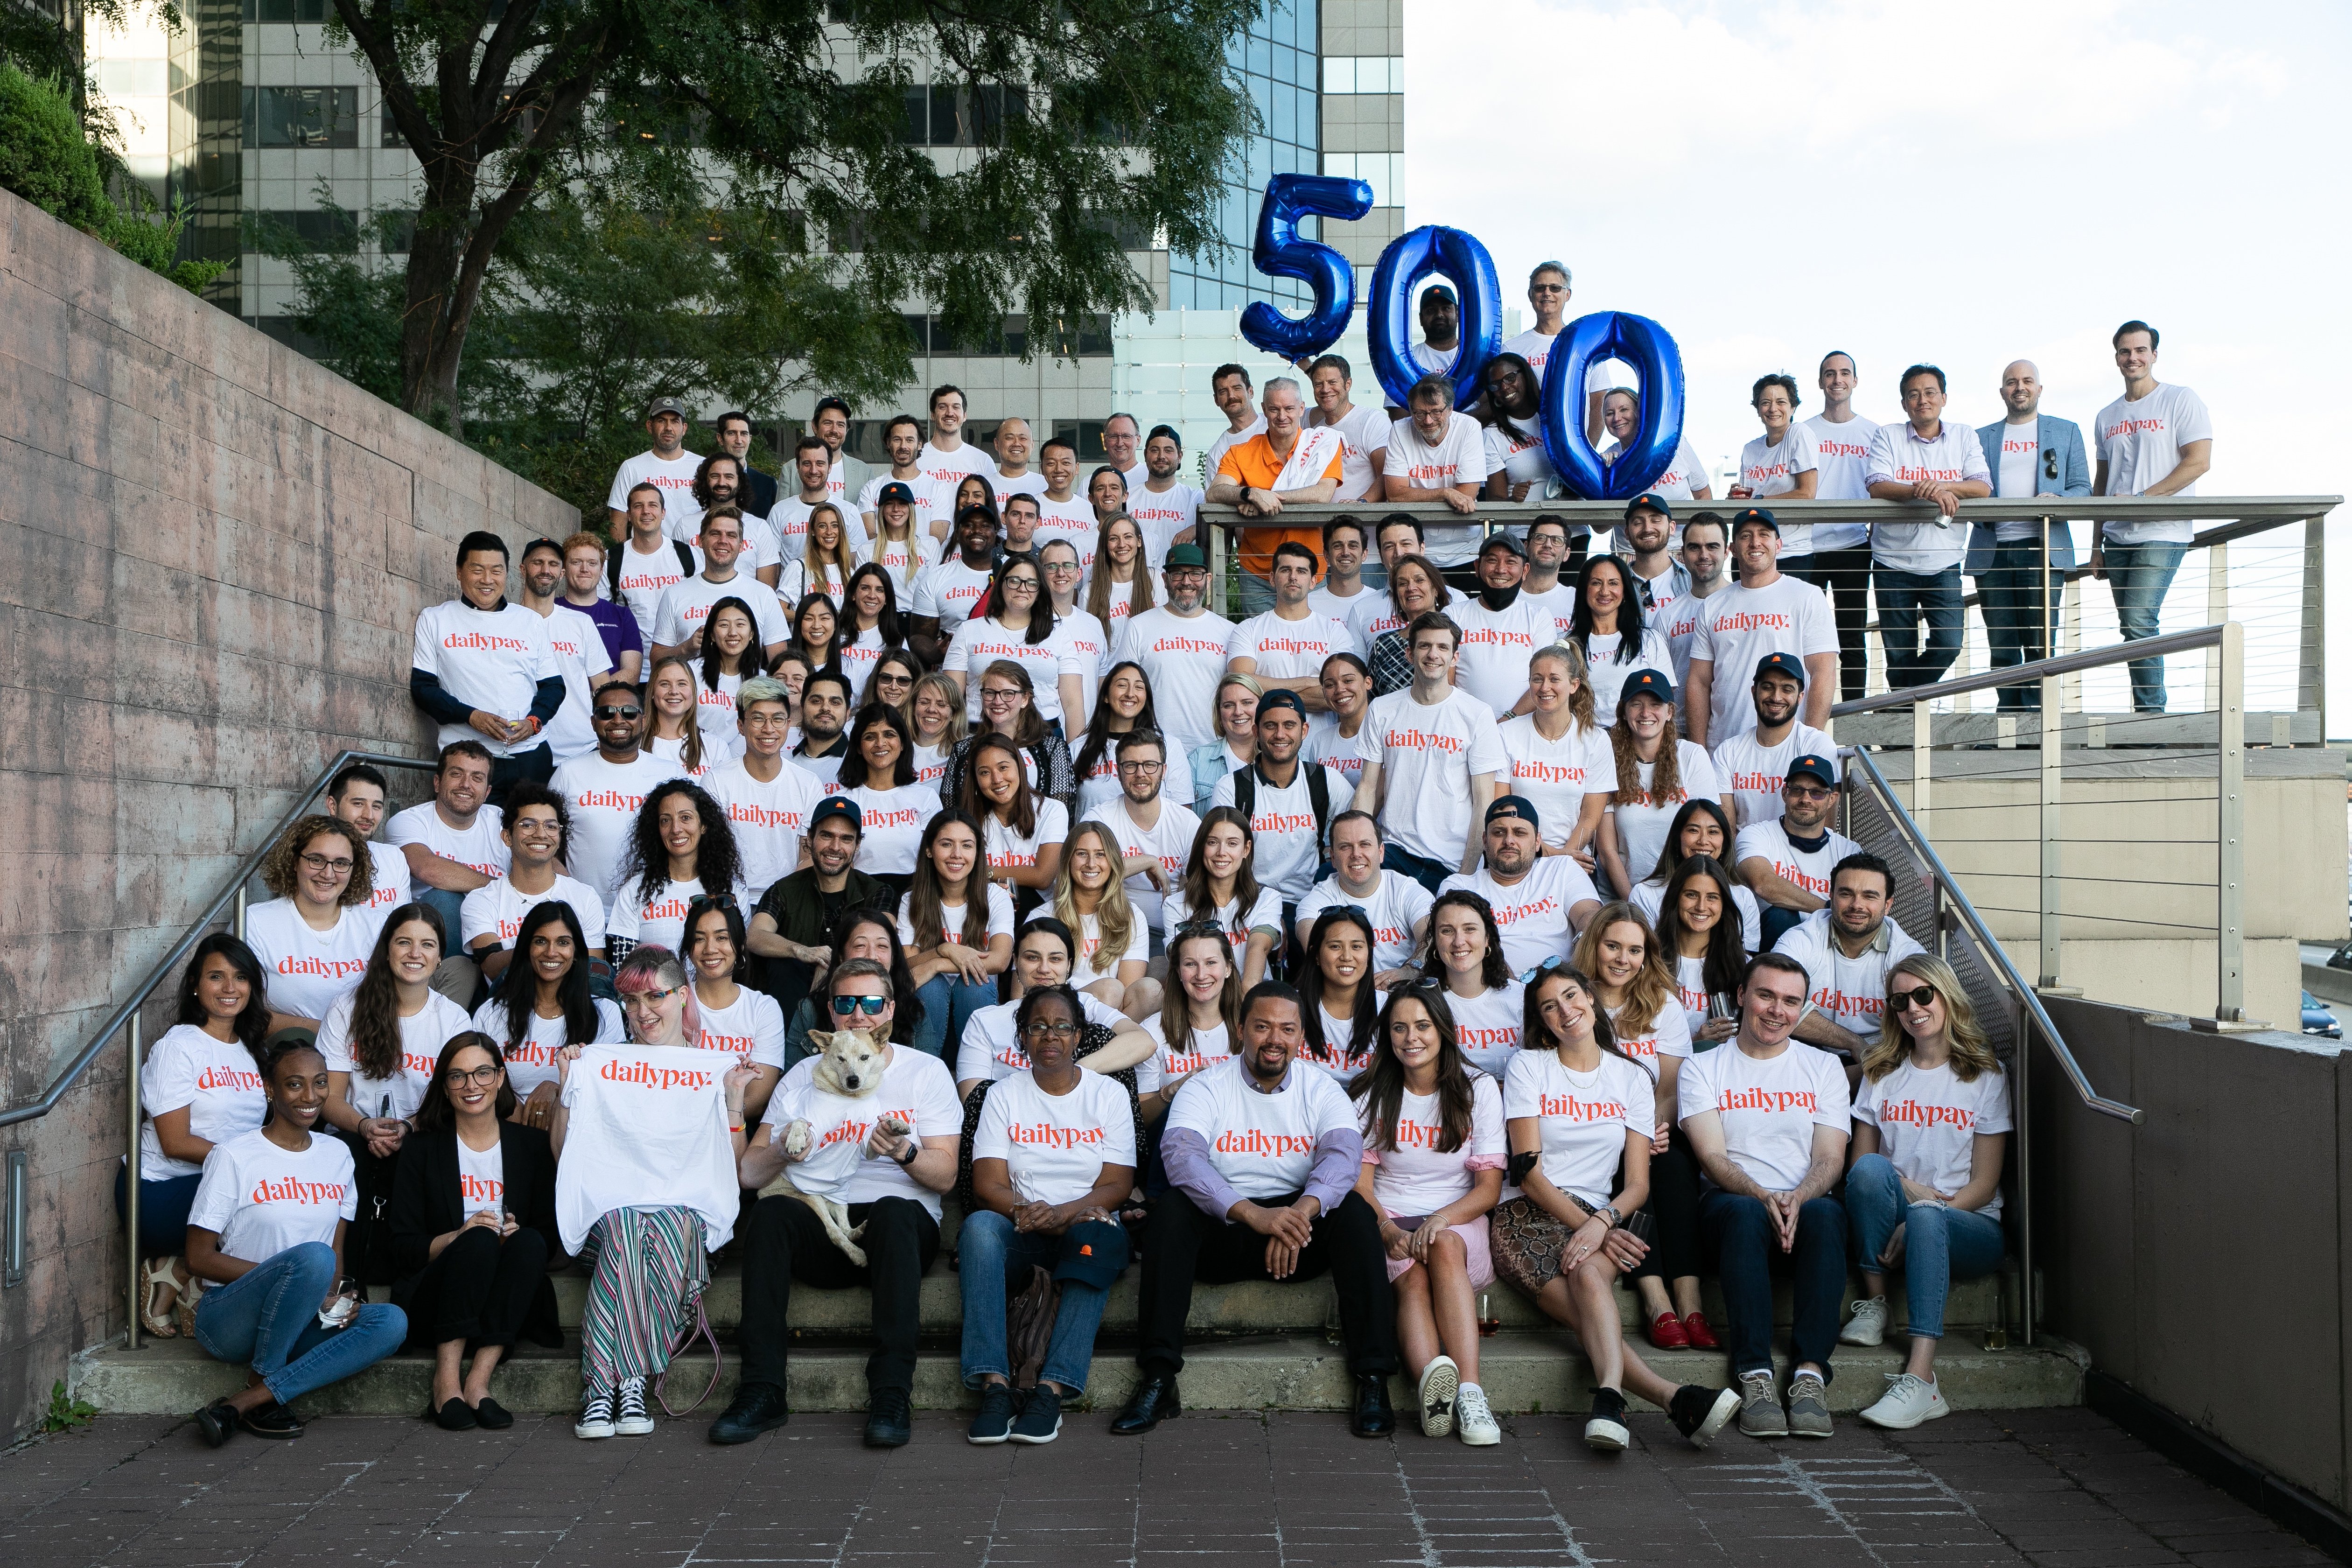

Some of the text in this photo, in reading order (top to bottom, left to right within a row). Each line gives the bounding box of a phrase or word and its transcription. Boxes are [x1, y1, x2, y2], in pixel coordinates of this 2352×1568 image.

[1820, 440, 1869, 458] ilypay.
[2002, 440, 2038, 453] ilyp
[643, 476, 694, 489] dailypa
[946, 586, 986, 601] daily
[1714, 612, 1789, 632] dailypay.
[444, 633, 529, 651] dailypay.
[974, 642, 1053, 659] dailypay.
[1154, 637, 1227, 655] dailypay.
[1259, 638, 1328, 655] dailypay.
[699, 689, 738, 710] daily
[1385, 729, 1463, 754] dailypay.
[1733, 772, 1787, 794] dailyp
[579, 791, 648, 812] dailyp
[642, 899, 691, 922] daily
[278, 956, 367, 979] dailypa
[198, 1066, 263, 1092] dailypa
[601, 1060, 712, 1092] dailypay.
[461, 1174, 504, 1203] ilyp
